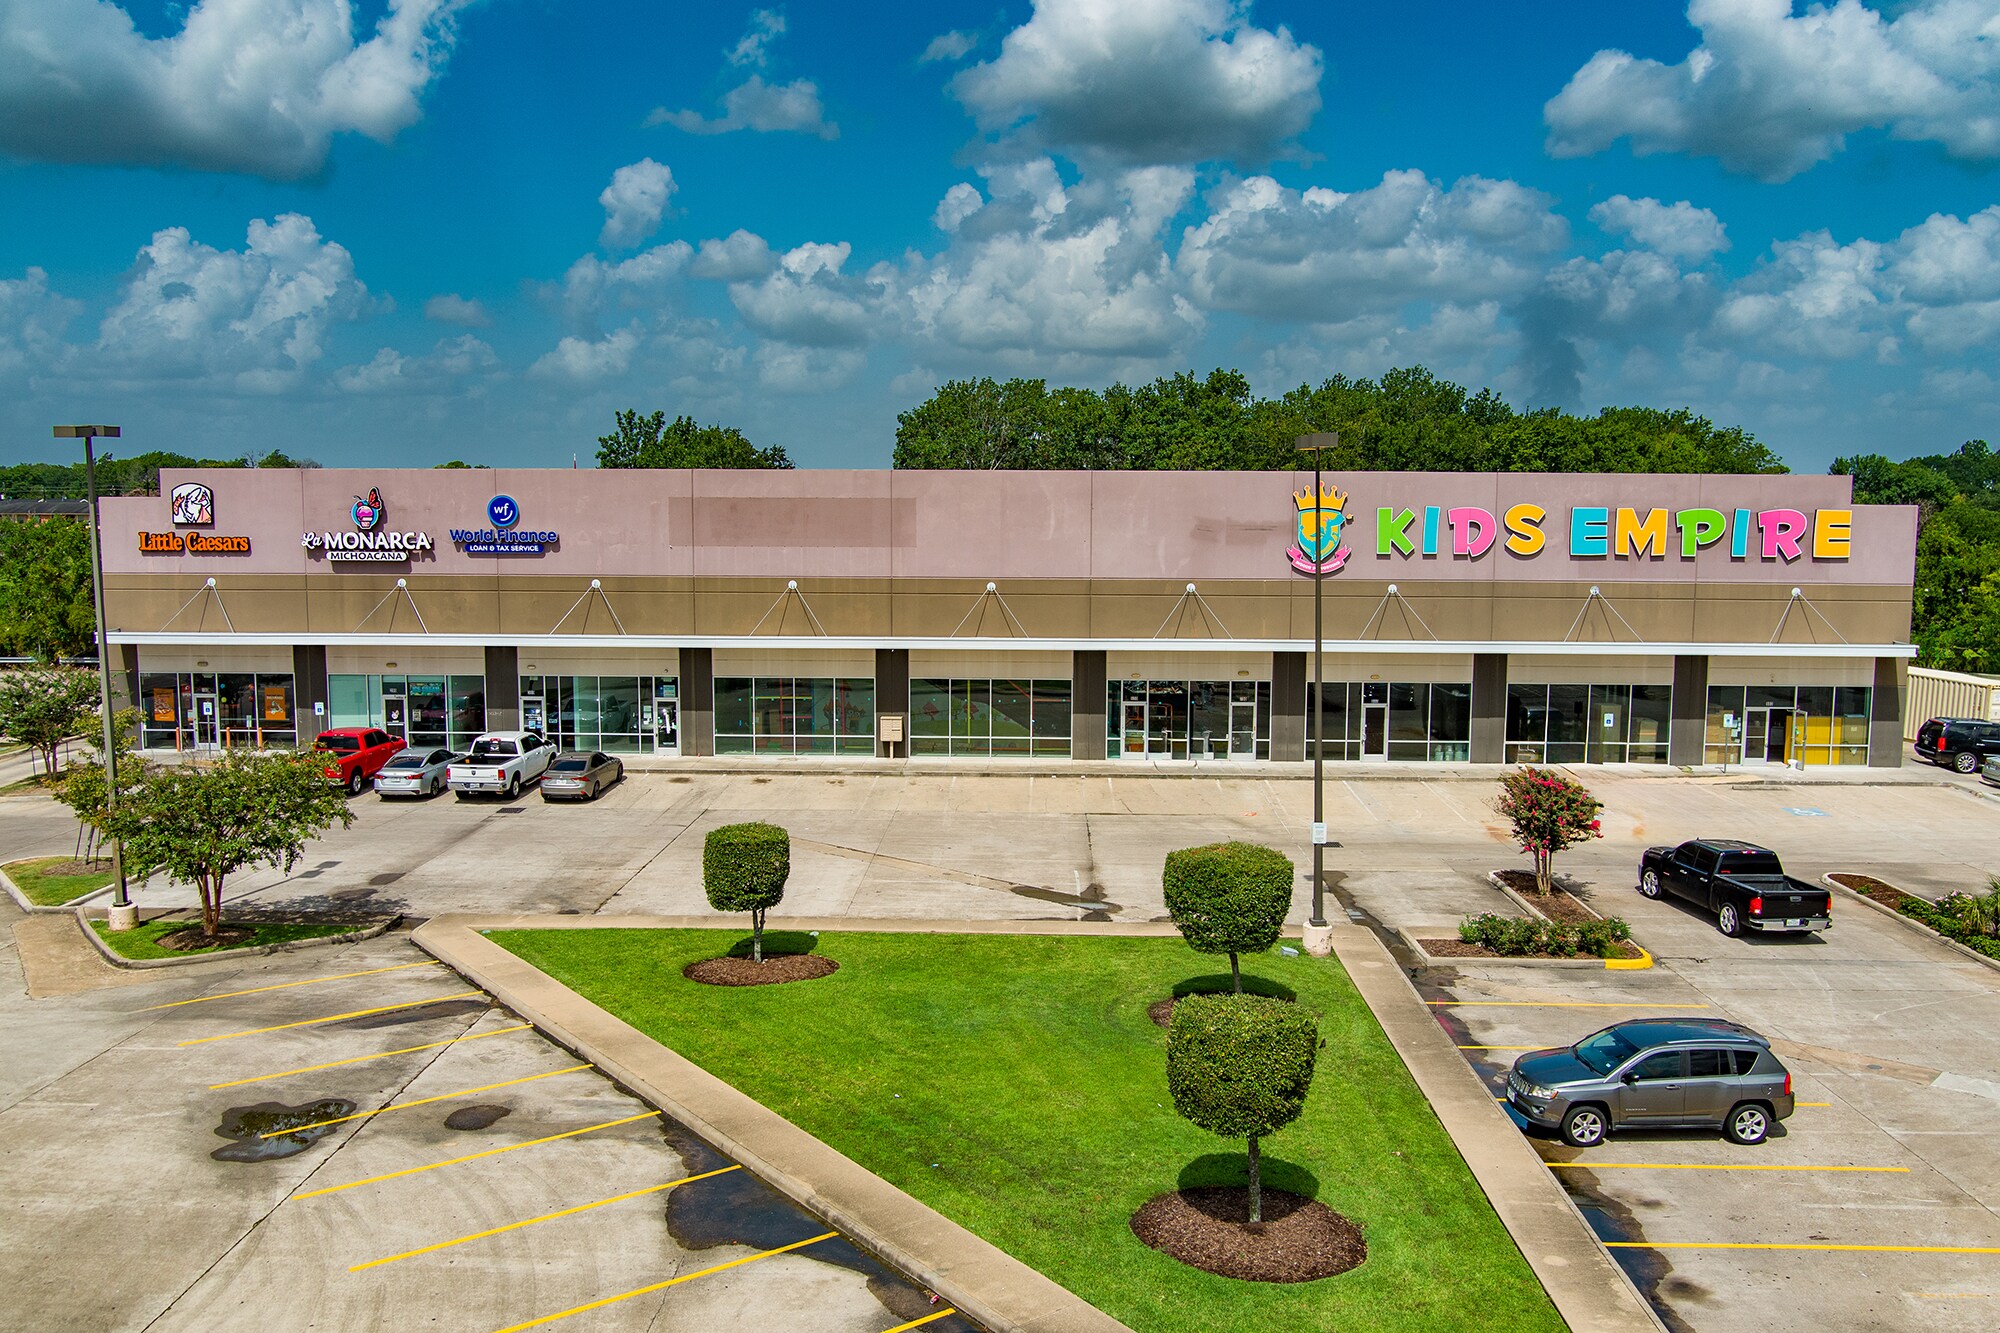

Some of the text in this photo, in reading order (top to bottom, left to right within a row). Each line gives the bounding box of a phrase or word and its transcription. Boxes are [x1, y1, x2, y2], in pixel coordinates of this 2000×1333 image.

[493, 502, 510, 516] wf
[449, 529, 557, 543] World Finance
[1376, 503, 1853, 562] KIDS EMPIRE
[138, 531, 250, 552] Little Caesars
[301, 531, 432, 550] La MONARCA
[469, 544, 488, 552] LOAN
[496, 544, 510, 552] TAX
[510, 544, 539, 552] SERVICE
[330, 552, 403, 560] MICHOACANA
